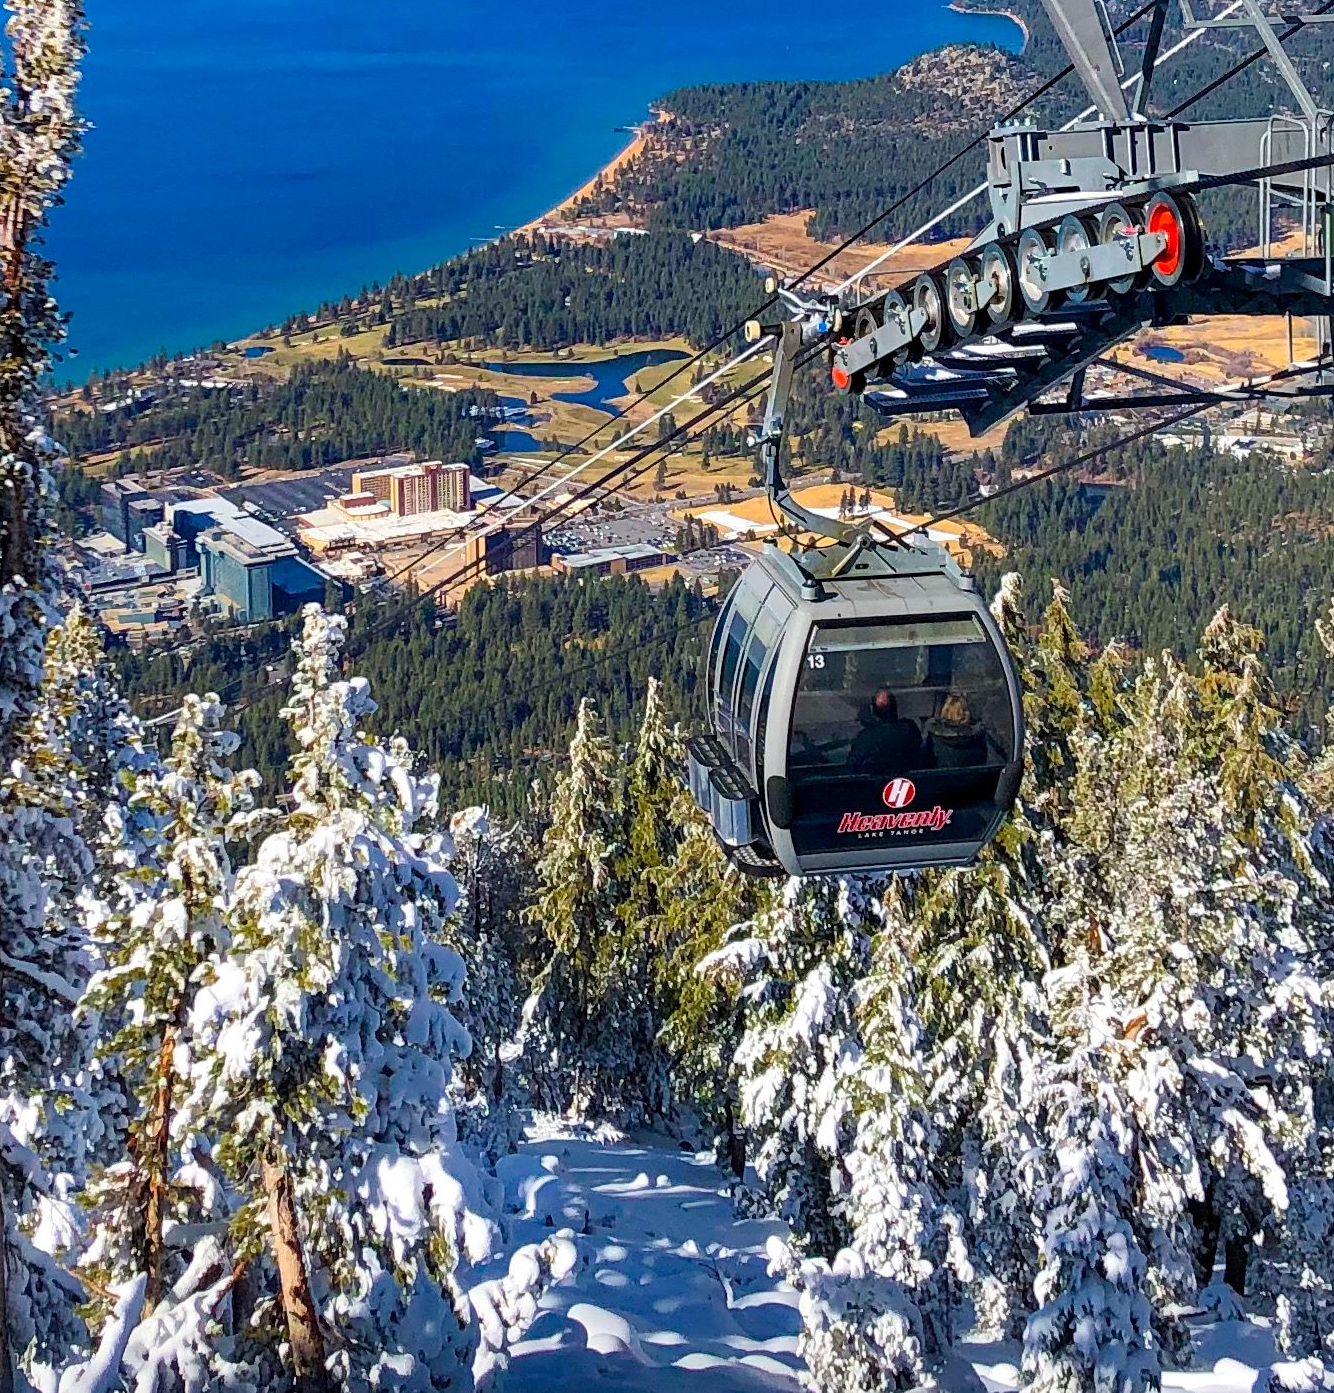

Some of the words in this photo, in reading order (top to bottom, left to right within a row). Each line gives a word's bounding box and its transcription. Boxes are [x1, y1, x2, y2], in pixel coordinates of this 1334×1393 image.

[807, 654, 825, 669] 13
[837, 806, 953, 833] Heavenly
[890, 828, 924, 836] TAHOE
